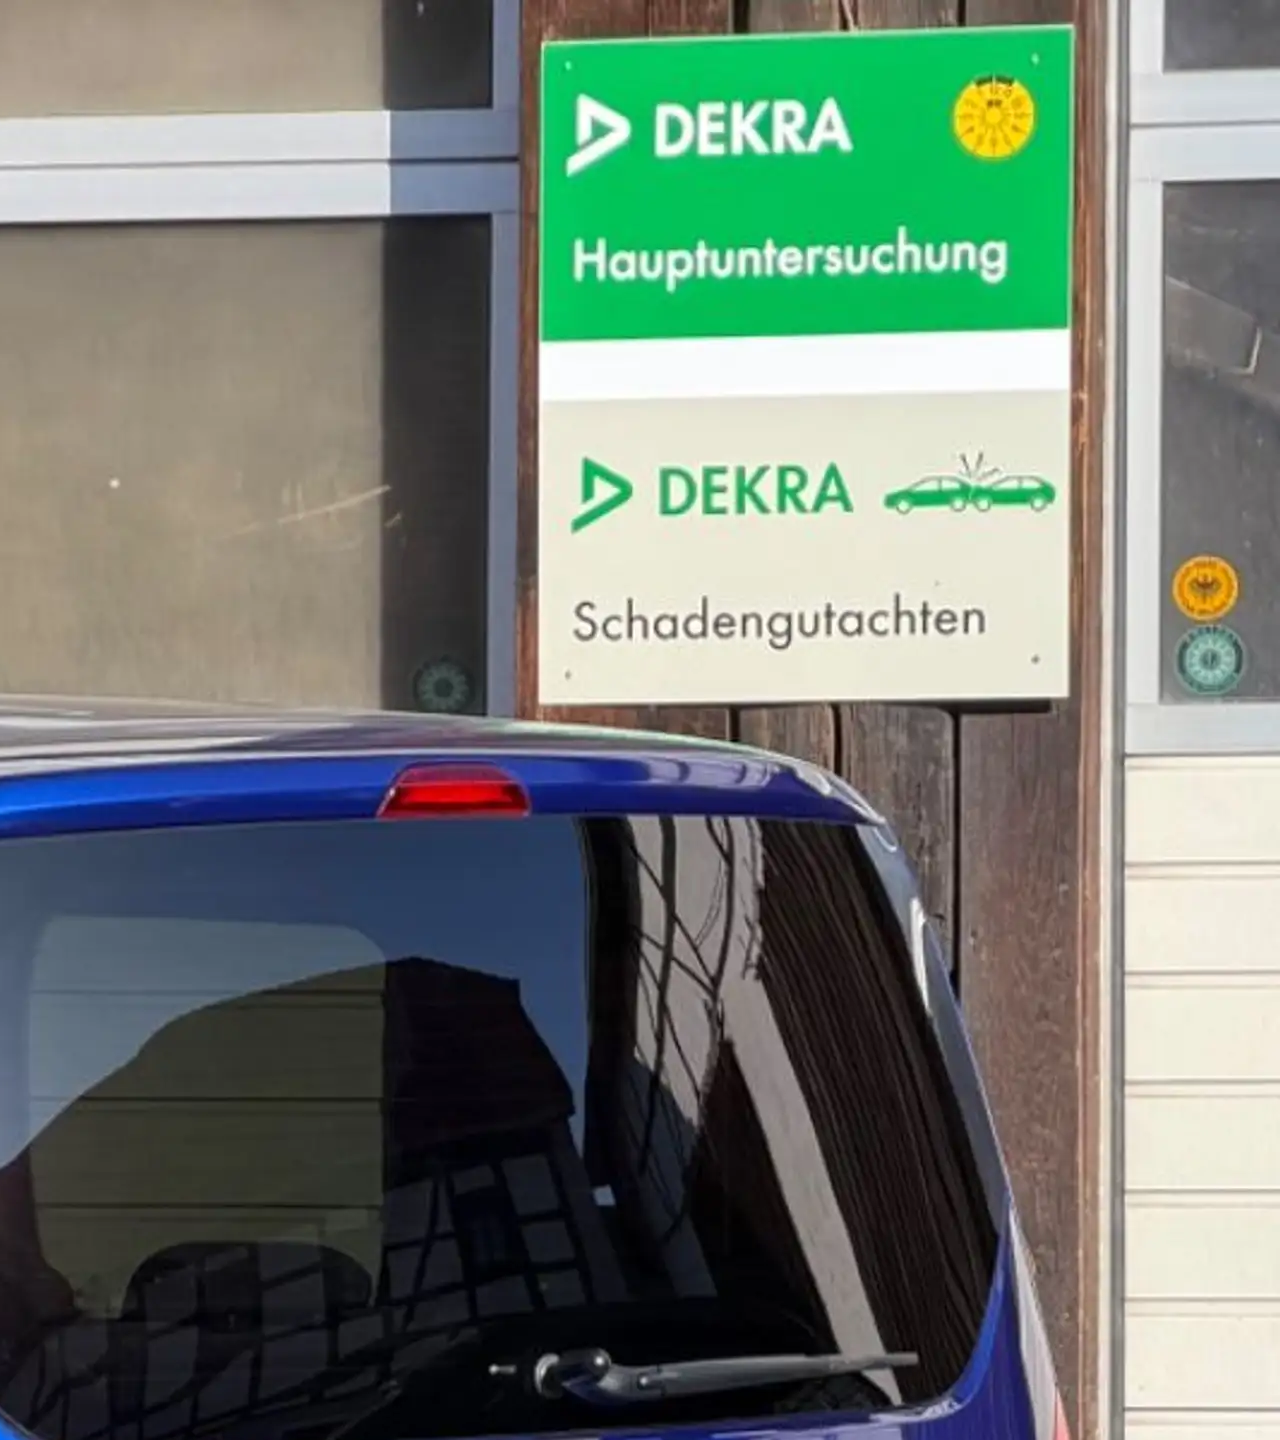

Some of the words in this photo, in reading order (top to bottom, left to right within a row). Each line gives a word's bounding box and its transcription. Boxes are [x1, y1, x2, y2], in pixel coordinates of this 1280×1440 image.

[654, 98, 853, 158] DEKRA
[572, 227, 1008, 292] Hauptuntersuchung
[657, 463, 853, 516] DEKRA
[572, 594, 987, 650] Schadengutachten
